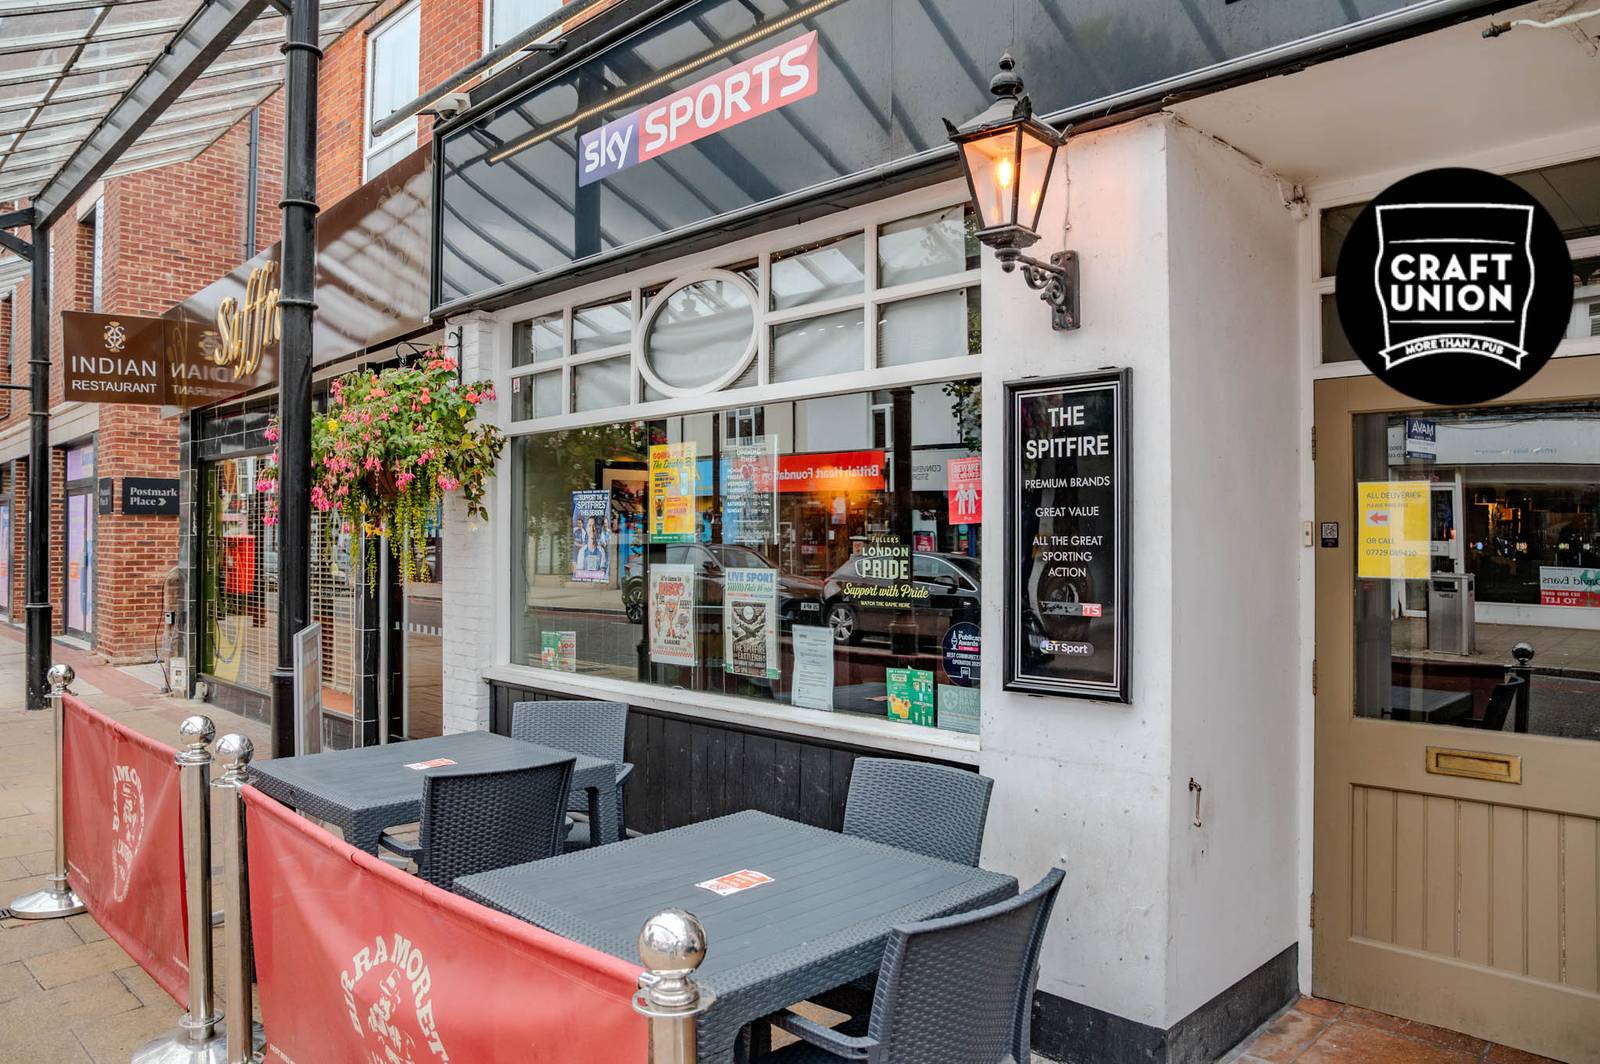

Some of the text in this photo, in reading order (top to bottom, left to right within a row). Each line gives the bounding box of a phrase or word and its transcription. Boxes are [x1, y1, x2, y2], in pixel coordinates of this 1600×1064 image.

[584, 44, 809, 173] sky SPORTS
[71, 355, 157, 377] INDIAN
[72, 380, 157, 395] RESTAURANT
[1048, 405, 1085, 427] THE
[1025, 434, 1109, 460] SPITFIRE
[1025, 476, 1110, 490] PREMIUM BRANDS
[130, 487, 178, 497] Postmark
[1367, 491, 1379, 499] ALL
[130, 497, 157, 506] Place
[576, 500, 606, 510] SPITFIRES
[1035, 506, 1099, 518] GREAT VALUE
[1032, 535, 1103, 546] ALL THE GREAT
[862, 546, 909, 557] LONDON
[1042, 551, 1092, 562] SPORTING
[862, 560, 909, 579] PRIDE
[1048, 567, 1087, 577] ACTION
[727, 571, 774, 583] LIVE SPORT
[843, 582, 929, 598] Support with Pride
[1061, 643, 1088, 655] Sport
